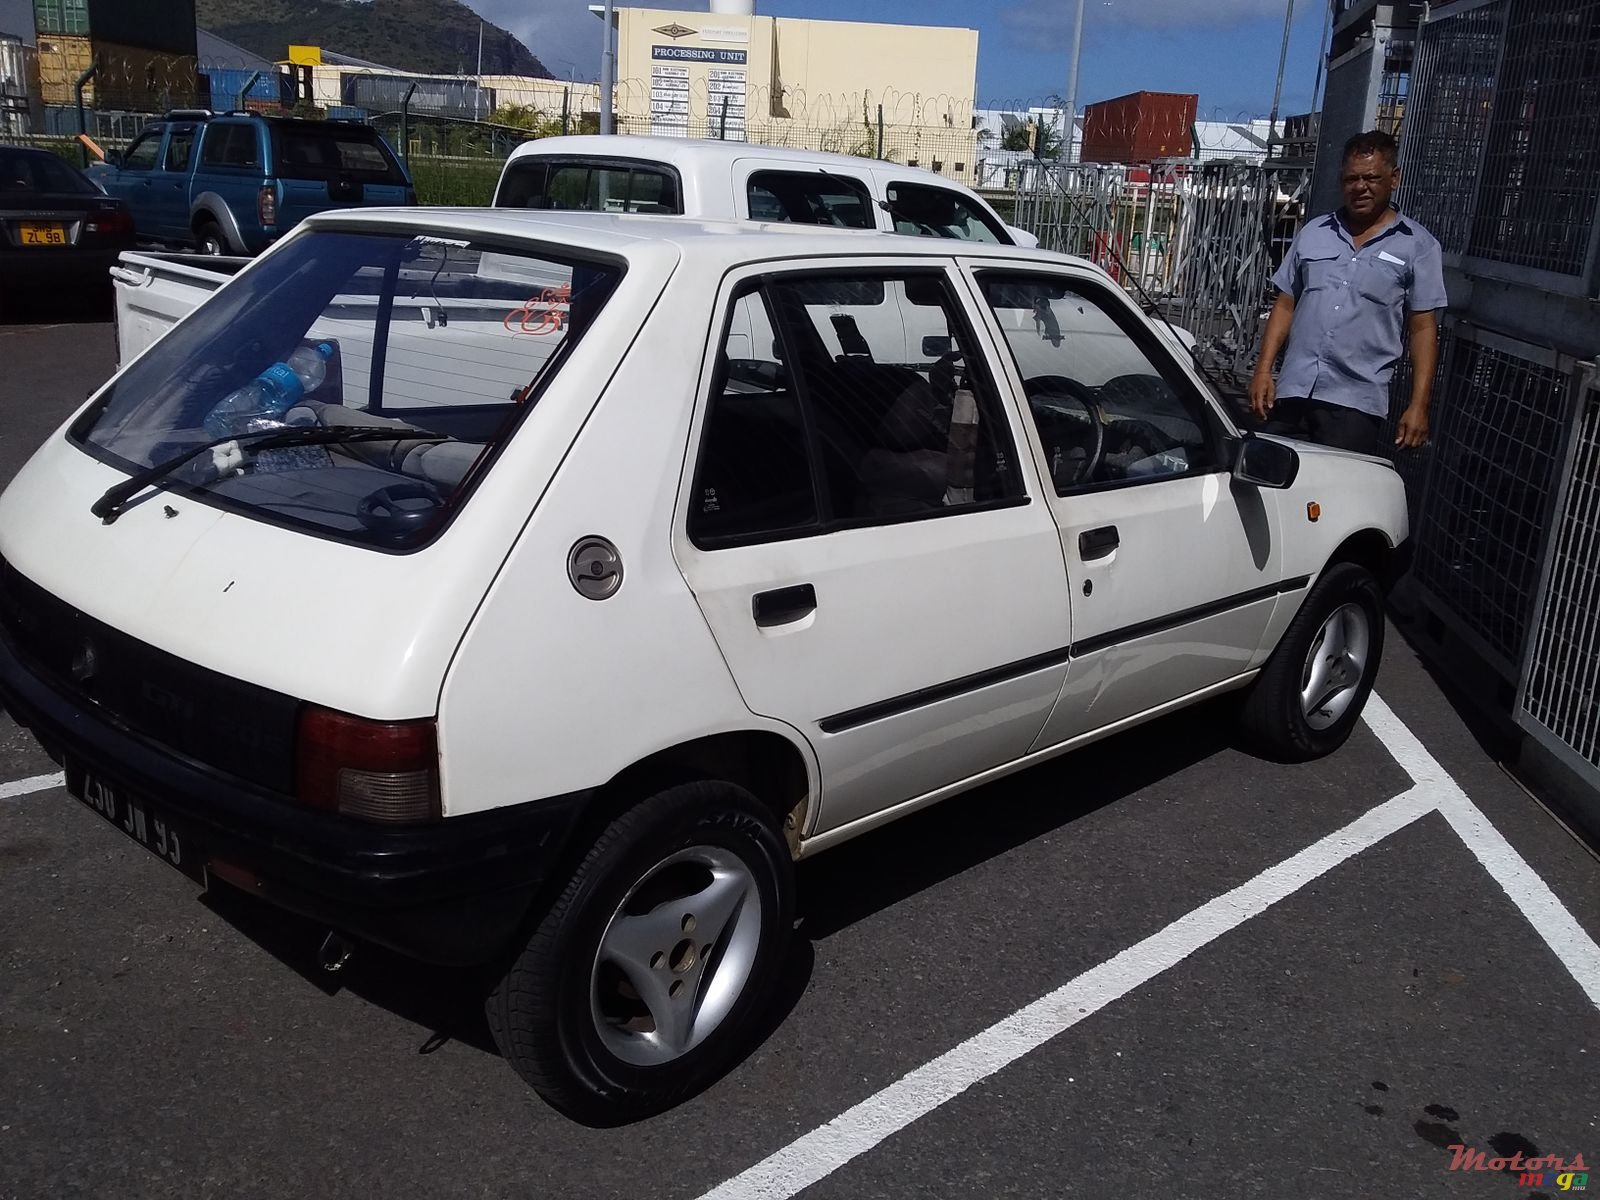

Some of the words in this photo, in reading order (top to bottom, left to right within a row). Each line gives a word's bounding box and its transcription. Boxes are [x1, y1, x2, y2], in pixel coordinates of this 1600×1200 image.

[654, 48, 715, 60] PROCESSING
[720, 51, 745, 61] UNIT
[27, 232, 42, 243] ZL
[46, 232, 61, 243] 98
